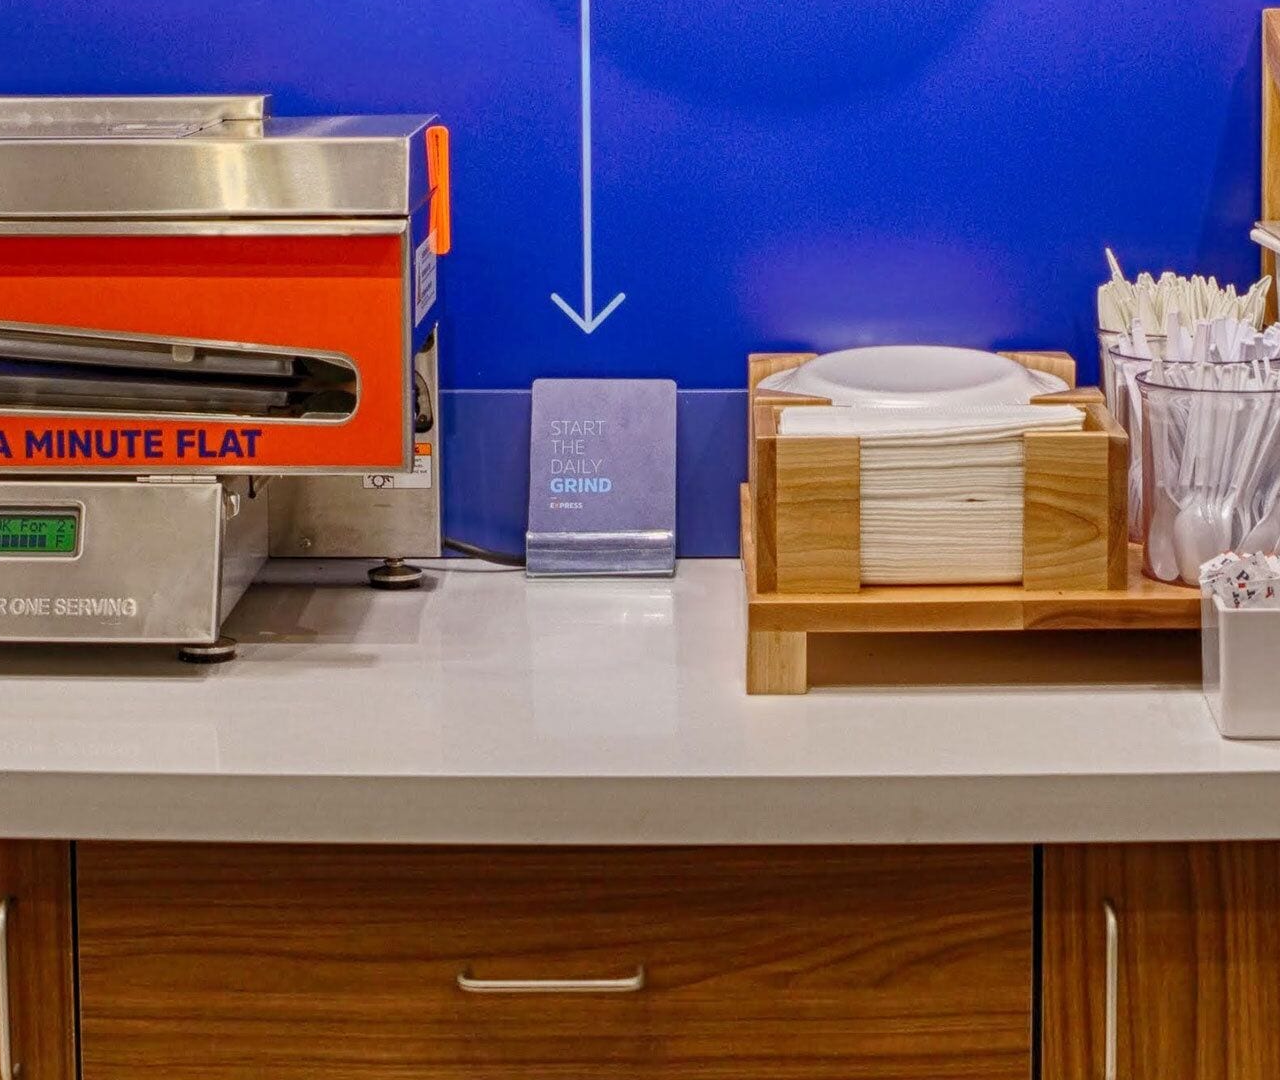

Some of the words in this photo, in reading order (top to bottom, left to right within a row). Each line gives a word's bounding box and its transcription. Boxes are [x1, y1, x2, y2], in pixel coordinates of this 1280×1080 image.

[550, 420, 605, 436] START
[25, 429, 163, 458] MINUTE
[177, 429, 262, 458] FLAT
[551, 439, 585, 455] THE
[550, 458, 603, 474] DAILY
[549, 477, 612, 493] GRIND
[9, 597, 50, 615] ONE
[54, 597, 136, 617] SERVING
